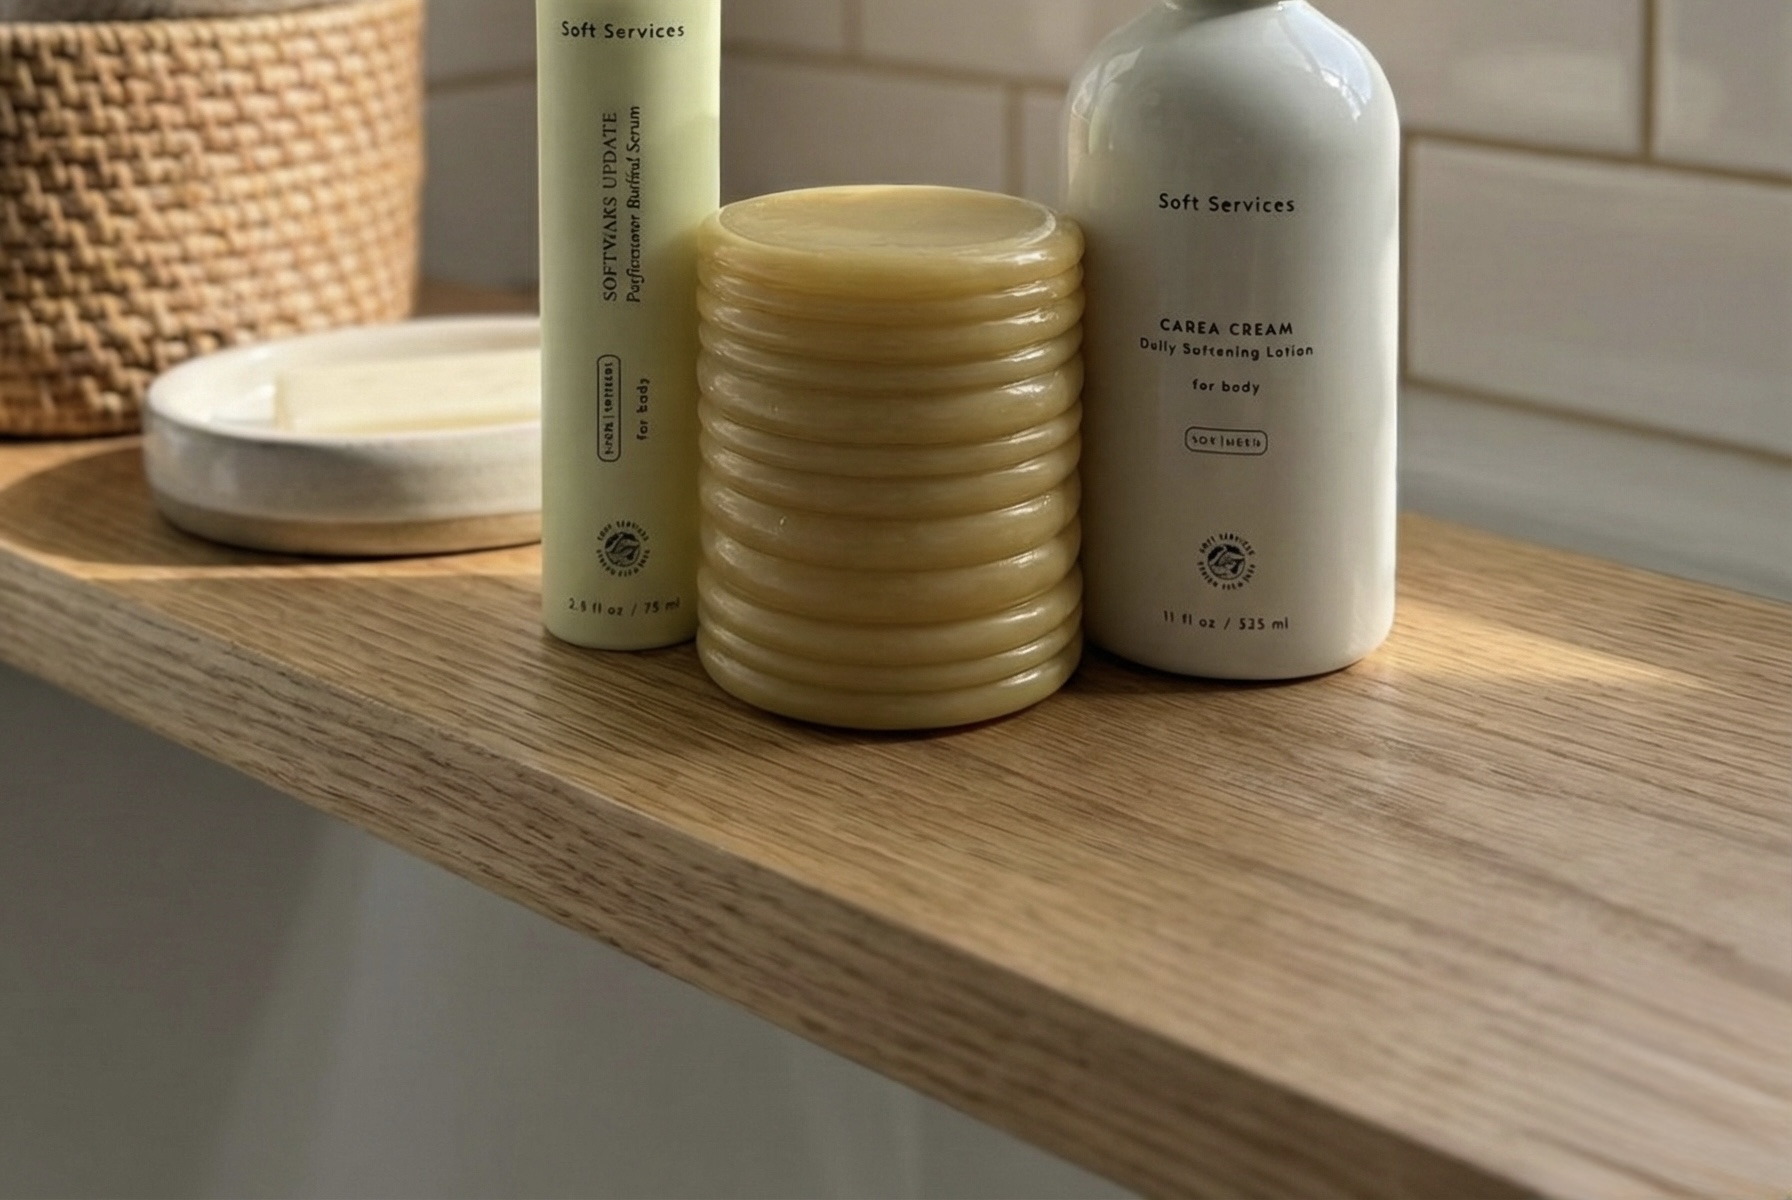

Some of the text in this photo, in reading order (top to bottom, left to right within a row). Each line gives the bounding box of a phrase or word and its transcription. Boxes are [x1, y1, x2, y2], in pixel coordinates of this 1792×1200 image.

[561, 20, 685, 39] Soft Services
[602, 112, 618, 189] UPDATE
[1158, 192, 1295, 214] Soft Services
[1159, 317, 1294, 337] CAREA CREAM
[1266, 344, 1314, 359] Lotion
[1192, 378, 1260, 397] for body
[636, 420, 649, 441] for
[1198, 617, 1216, 630] oz
[1271, 615, 1289, 631] ml
